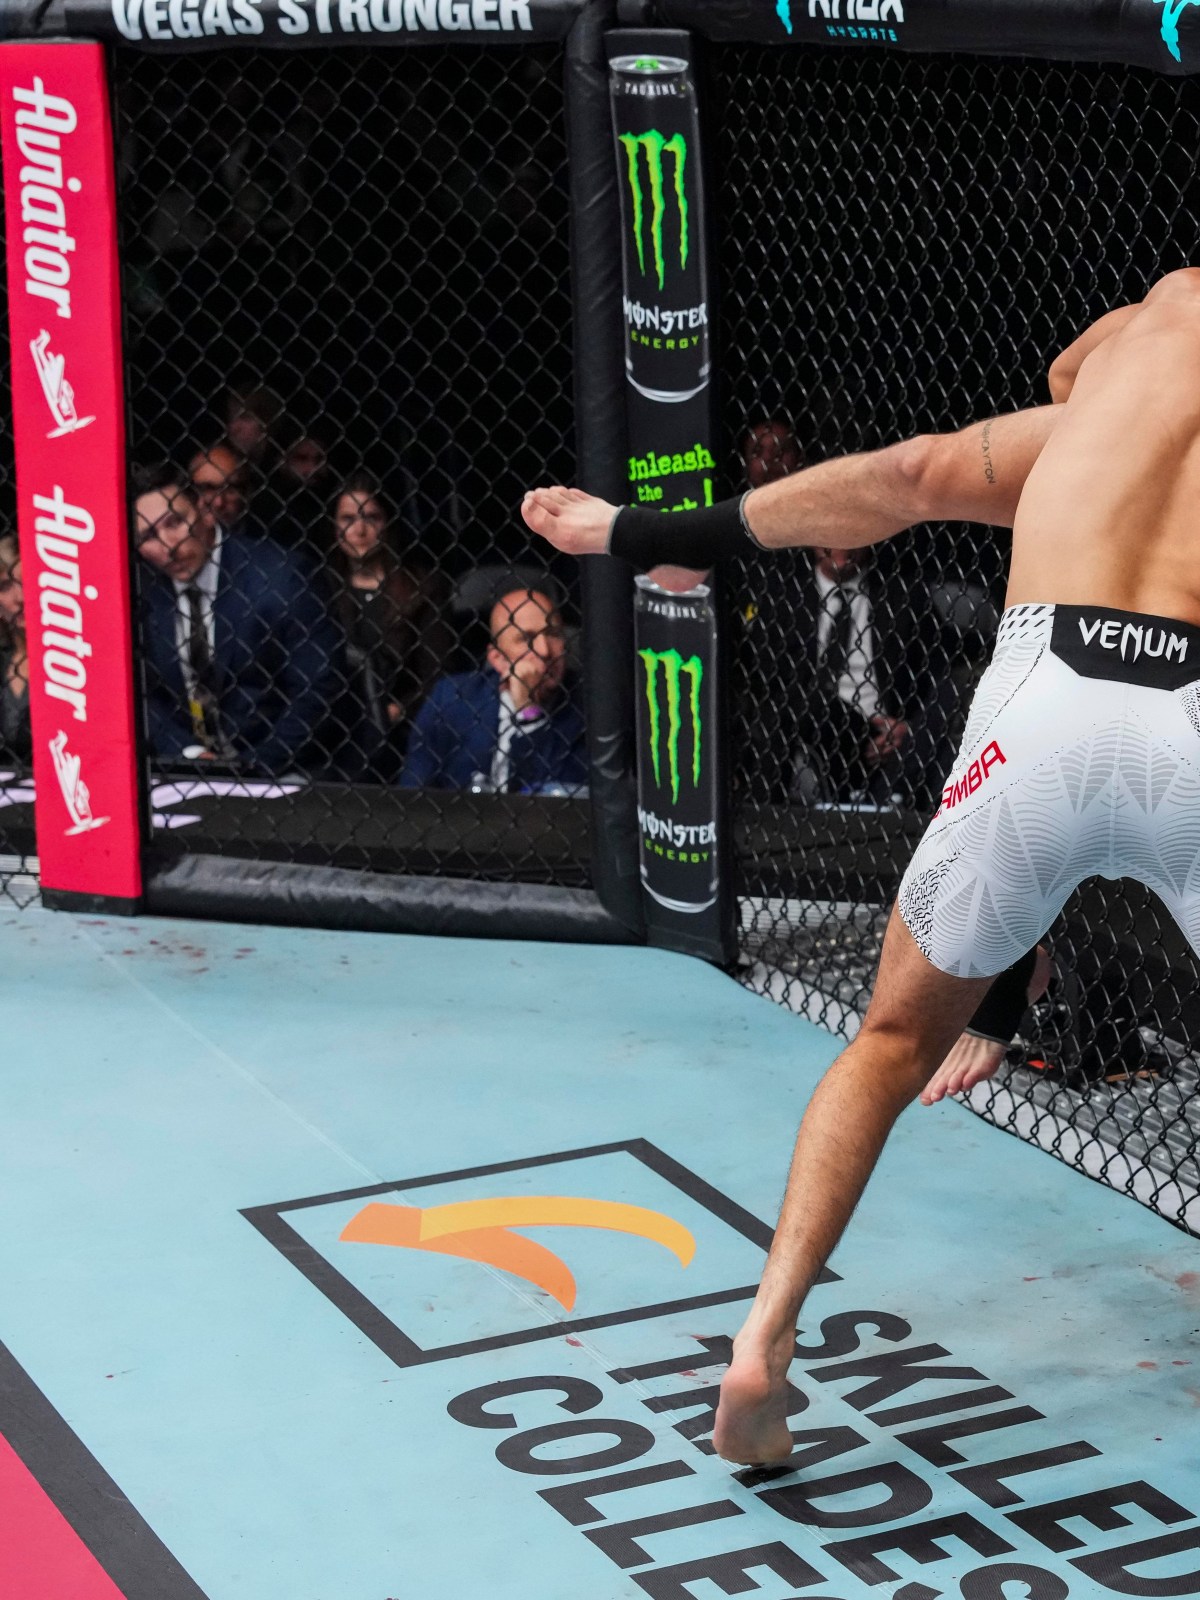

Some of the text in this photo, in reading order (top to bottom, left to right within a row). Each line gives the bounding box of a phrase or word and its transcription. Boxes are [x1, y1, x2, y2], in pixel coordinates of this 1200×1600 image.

[113, 0, 533, 40] VEGAS STRONGER
[826, 25, 898, 42] HYDRATE
[13, 76, 82, 319] Aviator
[631, 330, 699, 350] ENERGY
[637, 484, 663, 502] the
[33, 485, 98, 722] Aviator
[1078, 616, 1189, 664] VENUM
[933, 740, 1007, 819] AMBA
[645, 838, 709, 863] ENERGY
[447, 1375, 846, 1600] COLLE
